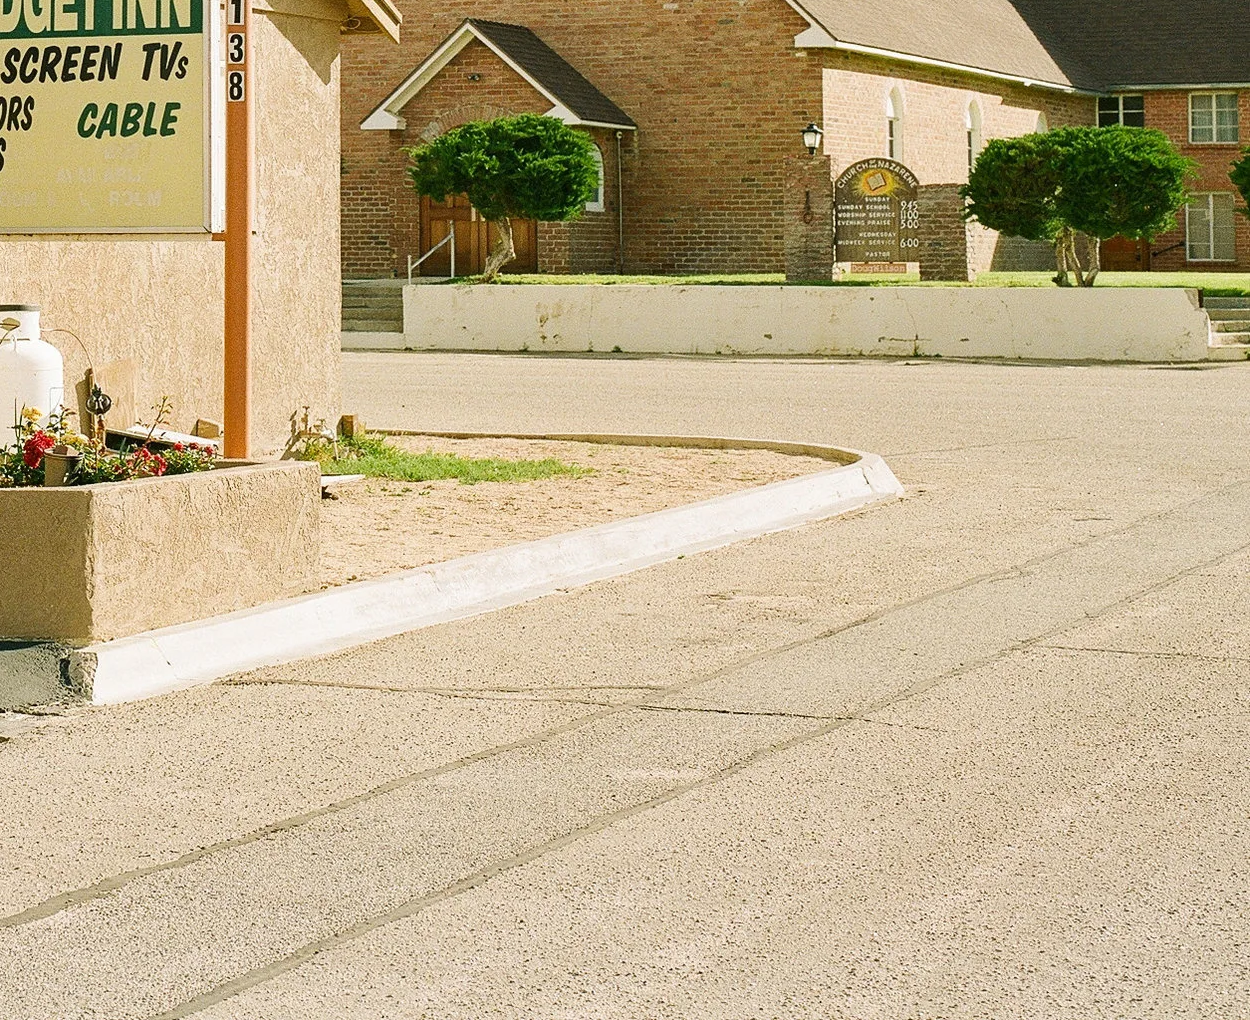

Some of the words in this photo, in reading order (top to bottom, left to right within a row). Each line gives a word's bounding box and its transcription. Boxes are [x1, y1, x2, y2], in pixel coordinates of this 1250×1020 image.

[0, 43, 123, 85] SCREEN
[142, 41, 189, 82] TVs
[77, 101, 181, 140] CABLE
[837, 162, 869, 188] CHURCH
[877, 160, 918, 188] NAZARENE
